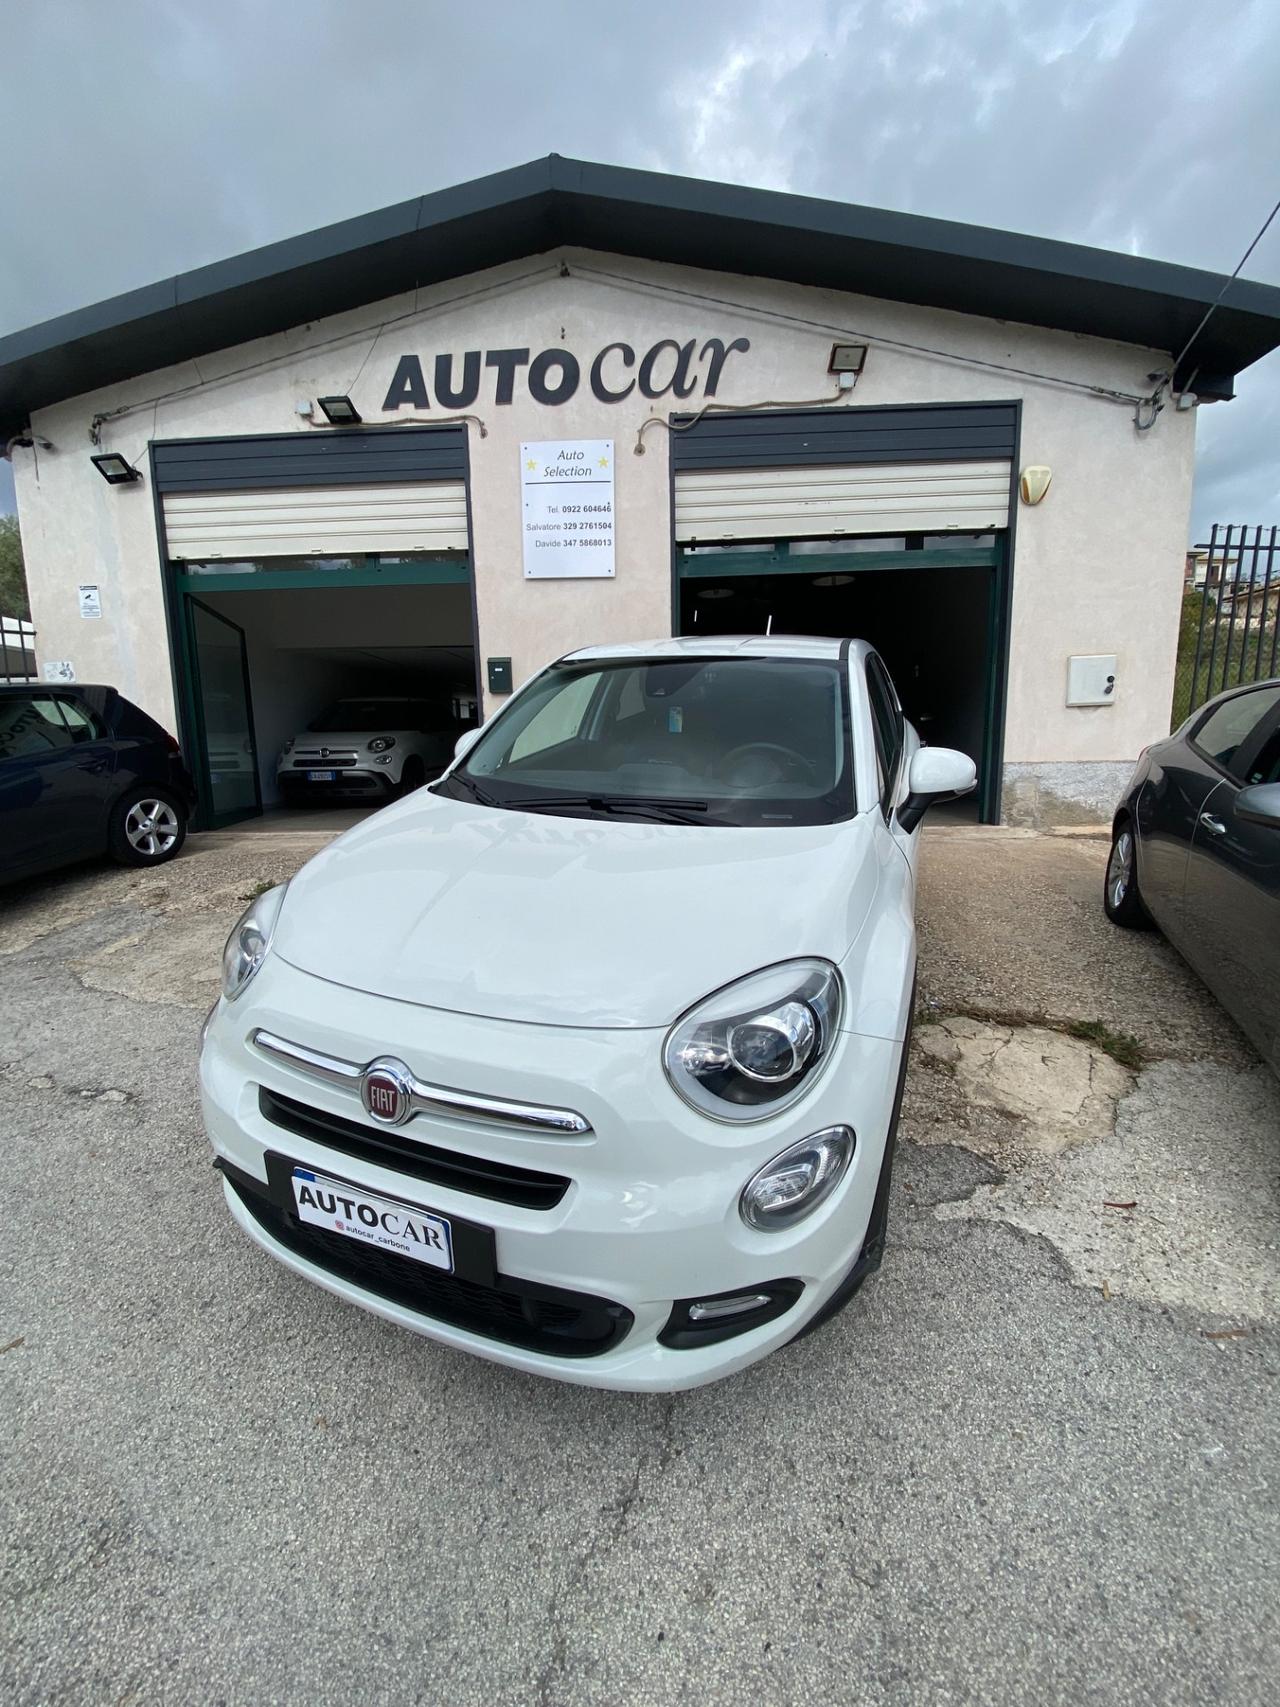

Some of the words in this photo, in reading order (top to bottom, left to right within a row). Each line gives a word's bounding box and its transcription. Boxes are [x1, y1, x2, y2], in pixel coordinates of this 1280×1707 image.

[557, 450, 585, 461] Auto
[543, 466, 593, 478] Selection
[562, 505, 581, 513] 0922
[583, 505, 612, 513] 604646
[526, 523, 561, 531] Salvatore
[563, 522, 578, 530] 329
[579, 522, 612, 530] 2761504
[535, 539, 561, 548] Davide
[563, 539, 577, 547] 347
[579, 539, 612, 547] 5868013
[370, 1086, 396, 1112] FIAT
